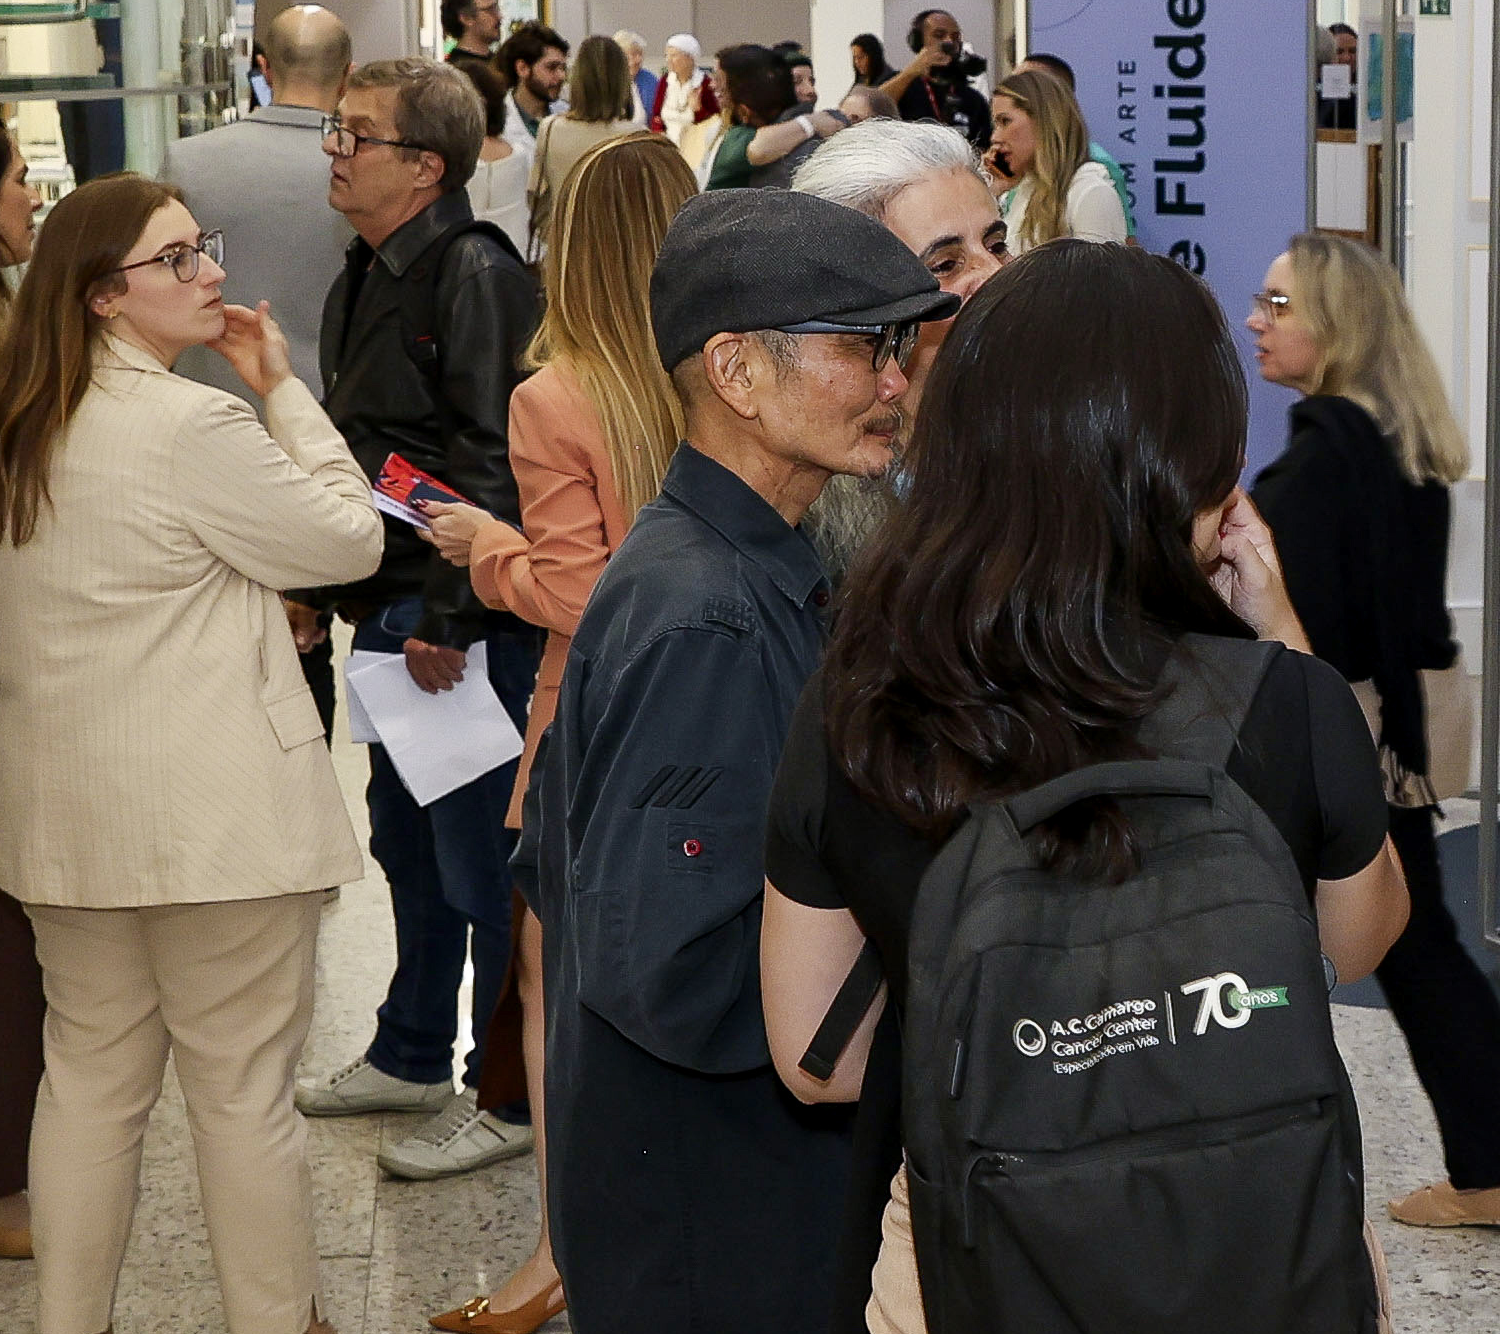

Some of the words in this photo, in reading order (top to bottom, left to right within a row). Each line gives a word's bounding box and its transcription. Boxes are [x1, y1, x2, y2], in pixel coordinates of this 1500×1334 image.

[1118, 60, 1137, 144] ARTE
[1180, 971, 1252, 1036] 70
[1240, 991, 1279, 1007] anos
[1052, 1030, 1104, 1057] Cancer
[1103, 1016, 1158, 1038] Center
[1115, 1040, 1135, 1054] em
[1133, 1033, 1160, 1049] Vida
